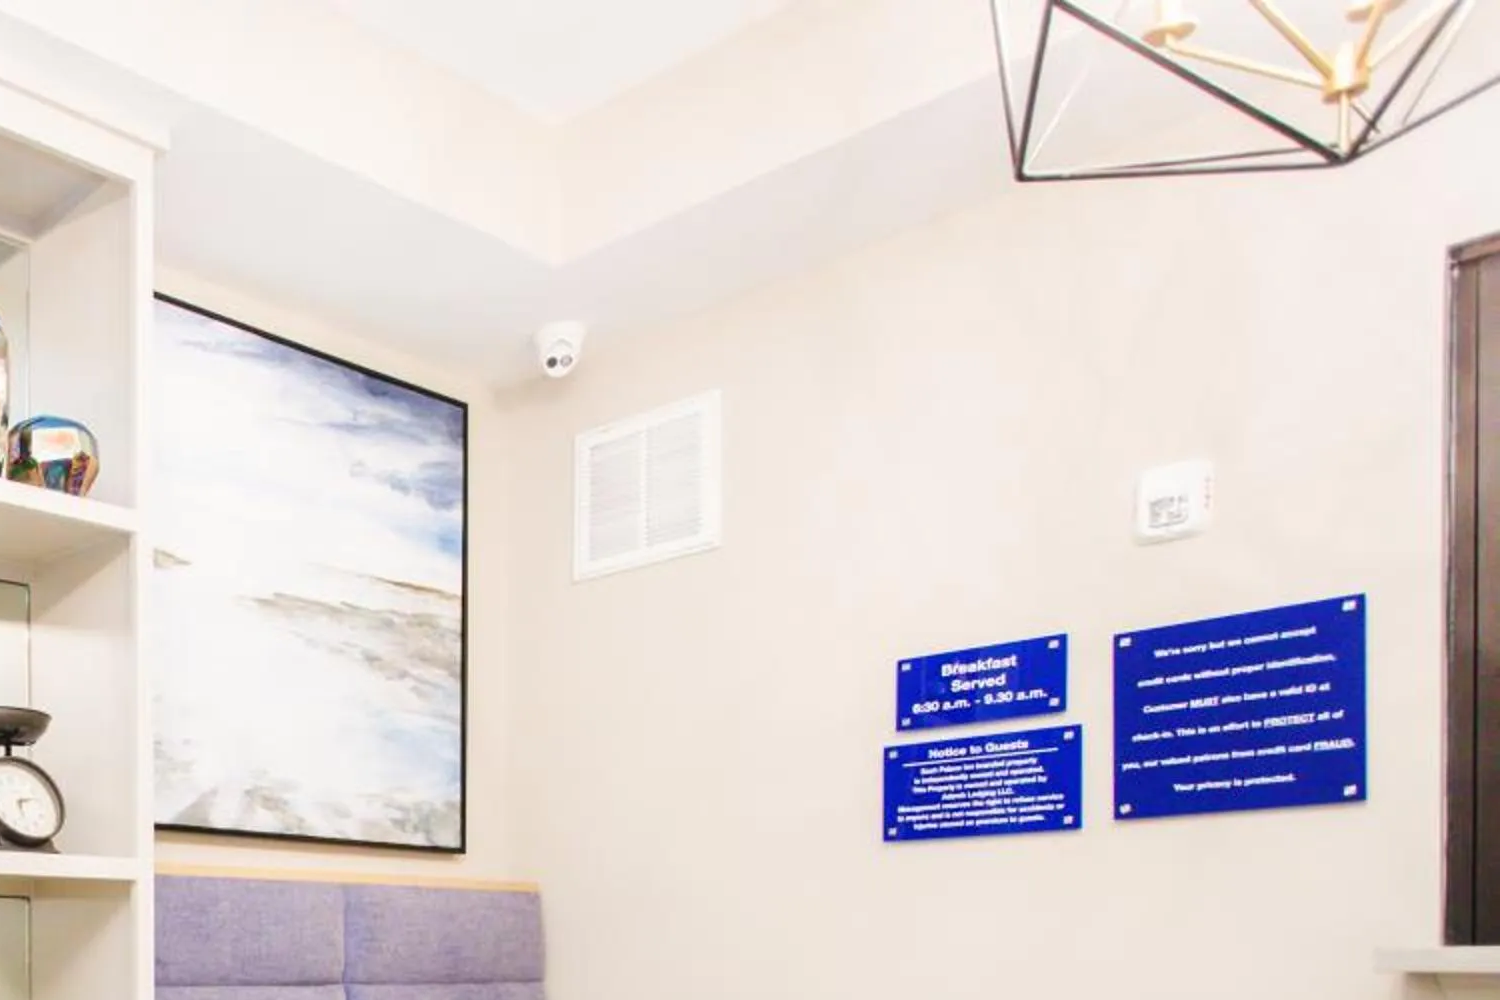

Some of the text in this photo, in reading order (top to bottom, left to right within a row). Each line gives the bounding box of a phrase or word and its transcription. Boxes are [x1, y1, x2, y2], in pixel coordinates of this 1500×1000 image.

[941, 654, 1017, 677] Breakfast
[951, 673, 1006, 692] Served
[942, 699, 971, 710] a.m.
[1015, 688, 1048, 700] a.m.
[928, 739, 1029, 758] Notice to Guests
